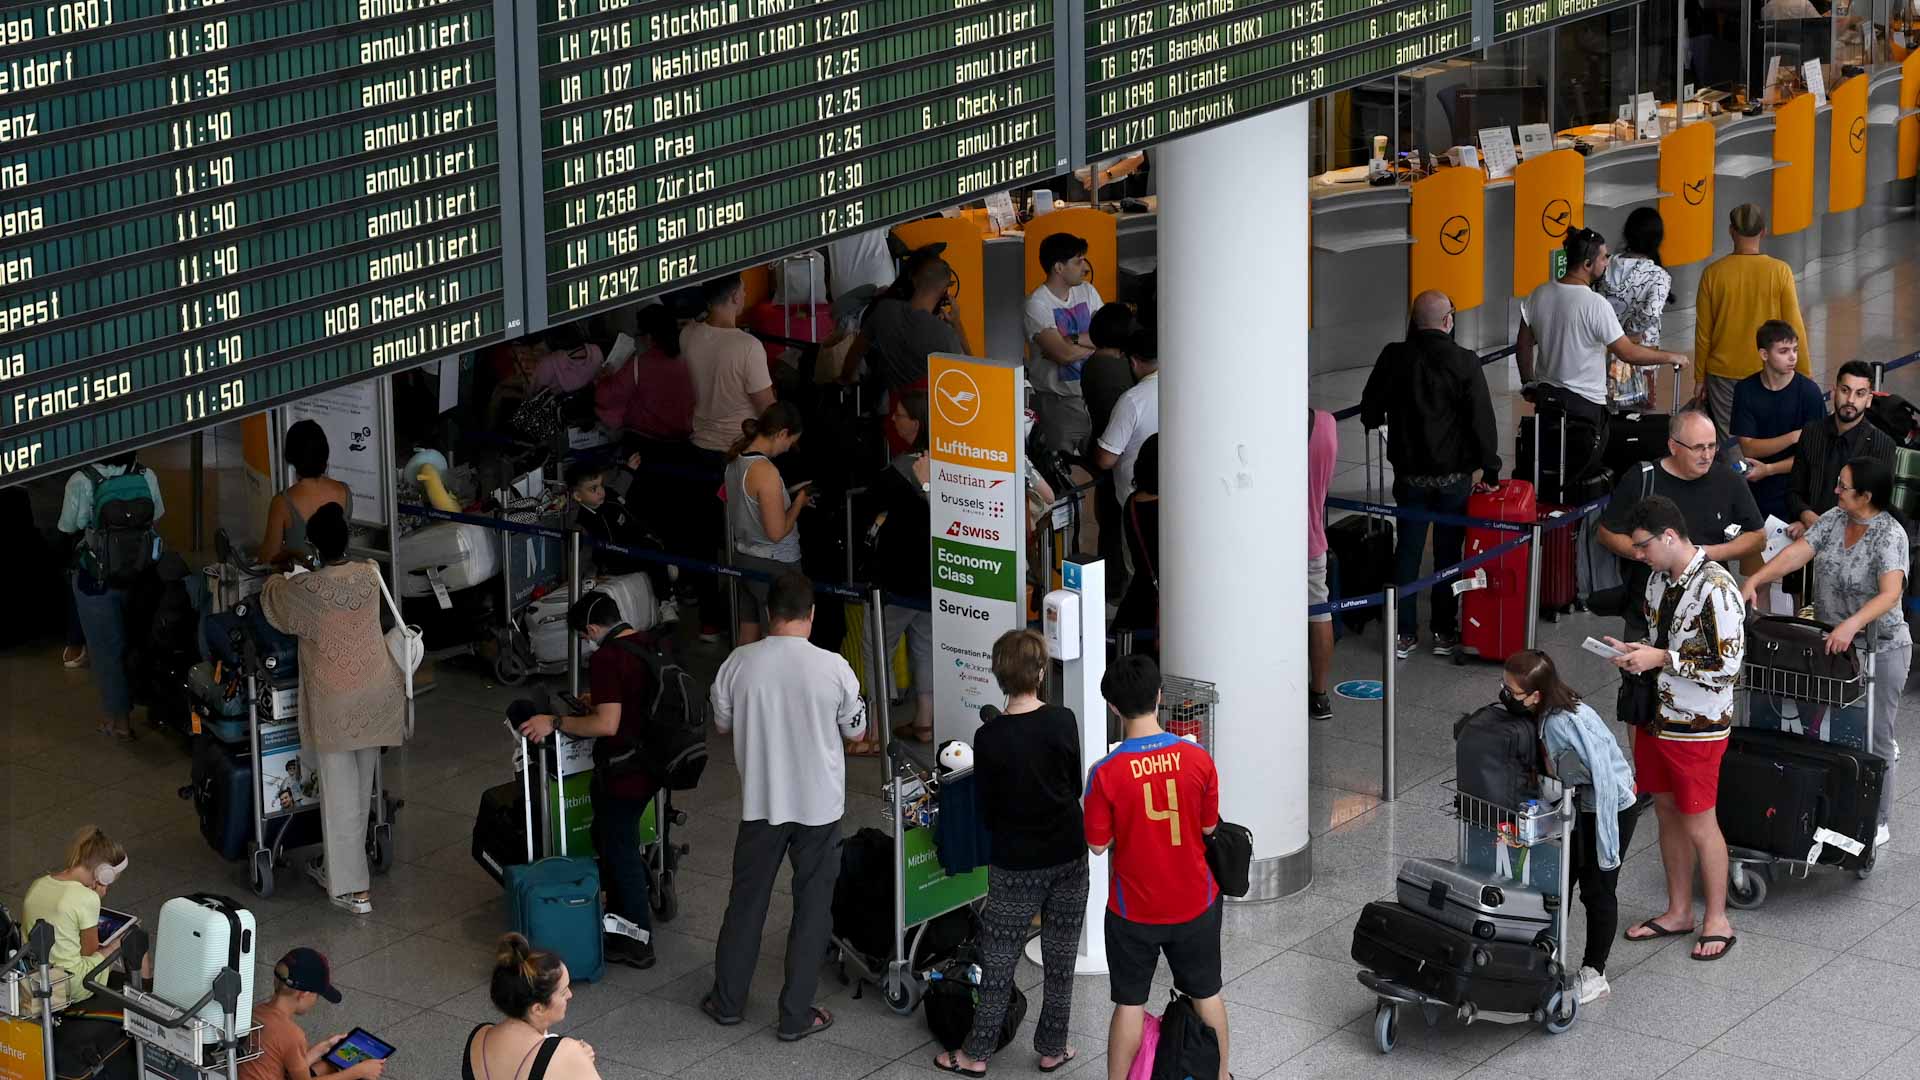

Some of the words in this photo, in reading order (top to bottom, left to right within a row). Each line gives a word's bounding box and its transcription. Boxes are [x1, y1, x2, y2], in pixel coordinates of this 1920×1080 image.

[169, 21, 227, 59] 11:30
[560, 34, 579, 62] LH
[591, 22, 630, 55] 2416
[651, 1, 737, 41] Stockholm
[1101, 20, 1115, 45] LH
[1125, 11, 1153, 38] 1762
[1101, 56, 1115, 80] TG
[1131, 46, 1153, 72] 925
[1169, 29, 1220, 62] Bangkok
[1292, 0, 1323, 28] 14:25
[1506, 11, 1517, 32] EN
[1524, 2, 1546, 27] 8204
[0, 113, 37, 142] enz
[171, 66, 229, 105] 11:35
[361, 16, 469, 64] annulliert
[561, 76, 581, 104] UA
[604, 63, 631, 94] 107
[652, 41, 748, 81] Washington
[816, 10, 858, 43] 12:20
[563, 116, 582, 145] LH
[604, 104, 633, 135] 762
[654, 88, 700, 122] Delhi
[817, 48, 859, 81] 12:25
[955, 5, 1035, 46] annulliert
[1102, 92, 1116, 117] LH
[1126, 81, 1153, 109] 1848
[1169, 64, 1226, 97] Alicante
[1292, 34, 1323, 62] 14:30
[1397, 1, 1446, 32] Check-in
[1102, 127, 1116, 152] LH
[1126, 116, 1154, 145] 1710
[1170, 94, 1233, 132] Dubrovnik
[1292, 68, 1323, 96] 14:30
[1397, 28, 1457, 64] annulliert
[173, 112, 231, 151] 11:40
[363, 59, 471, 107] annulliert
[564, 158, 584, 187] LH
[597, 145, 634, 178] 1690
[655, 136, 694, 163] Prag
[818, 87, 860, 120] 12:25
[956, 42, 1036, 84] annulliert
[0, 207, 43, 238] gna
[176, 157, 233, 196] 11:40
[365, 101, 472, 151] annulliert
[178, 202, 235, 241] 11:40
[366, 144, 474, 194] annulliert
[566, 199, 585, 228] LH
[597, 186, 636, 219] 2368
[657, 166, 714, 203] Zürich
[819, 125, 861, 159] 12:25
[957, 85, 1021, 120] Check-in
[567, 240, 586, 269] LH
[608, 226, 637, 255] 466
[658, 218, 686, 243] San
[697, 202, 743, 232] Diego
[820, 163, 862, 197] 12:30
[958, 114, 1037, 157] annulliert
[180, 247, 237, 286] 11:40
[368, 186, 475, 237] annulliert
[569, 281, 588, 309] LH
[599, 266, 638, 300] 2342
[660, 255, 697, 283] Graz
[822, 201, 863, 235] 12:35
[958, 151, 1037, 195] annulliert
[182, 291, 239, 331] 11:40
[370, 228, 477, 281] annulliert
[15, 372, 130, 423] Francisco
[184, 336, 241, 376] 11:40
[325, 303, 359, 337] H08
[372, 280, 459, 324] Check-in
[0, 443, 41, 475] ver
[187, 380, 243, 421] 11:50
[373, 312, 480, 366] annulliert
[936, 437, 1008, 463] Lufthansa
[938, 467, 986, 489] Austrian
[941, 492, 985, 510] brussels
[962, 526, 1000, 541] SWISS
[1365, 504, 1392, 515] Lufthansa
[1493, 521, 1520, 531] Lufthansa
[938, 548, 1001, 575] Economy
[938, 565, 974, 585] Class
[939, 599, 990, 621] Service
[1340, 597, 1368, 608] Lufthansa
[941, 643, 981, 659] Cooperation
[1130, 752, 1181, 779] DOHHY
[1143, 778, 1182, 846] 4
